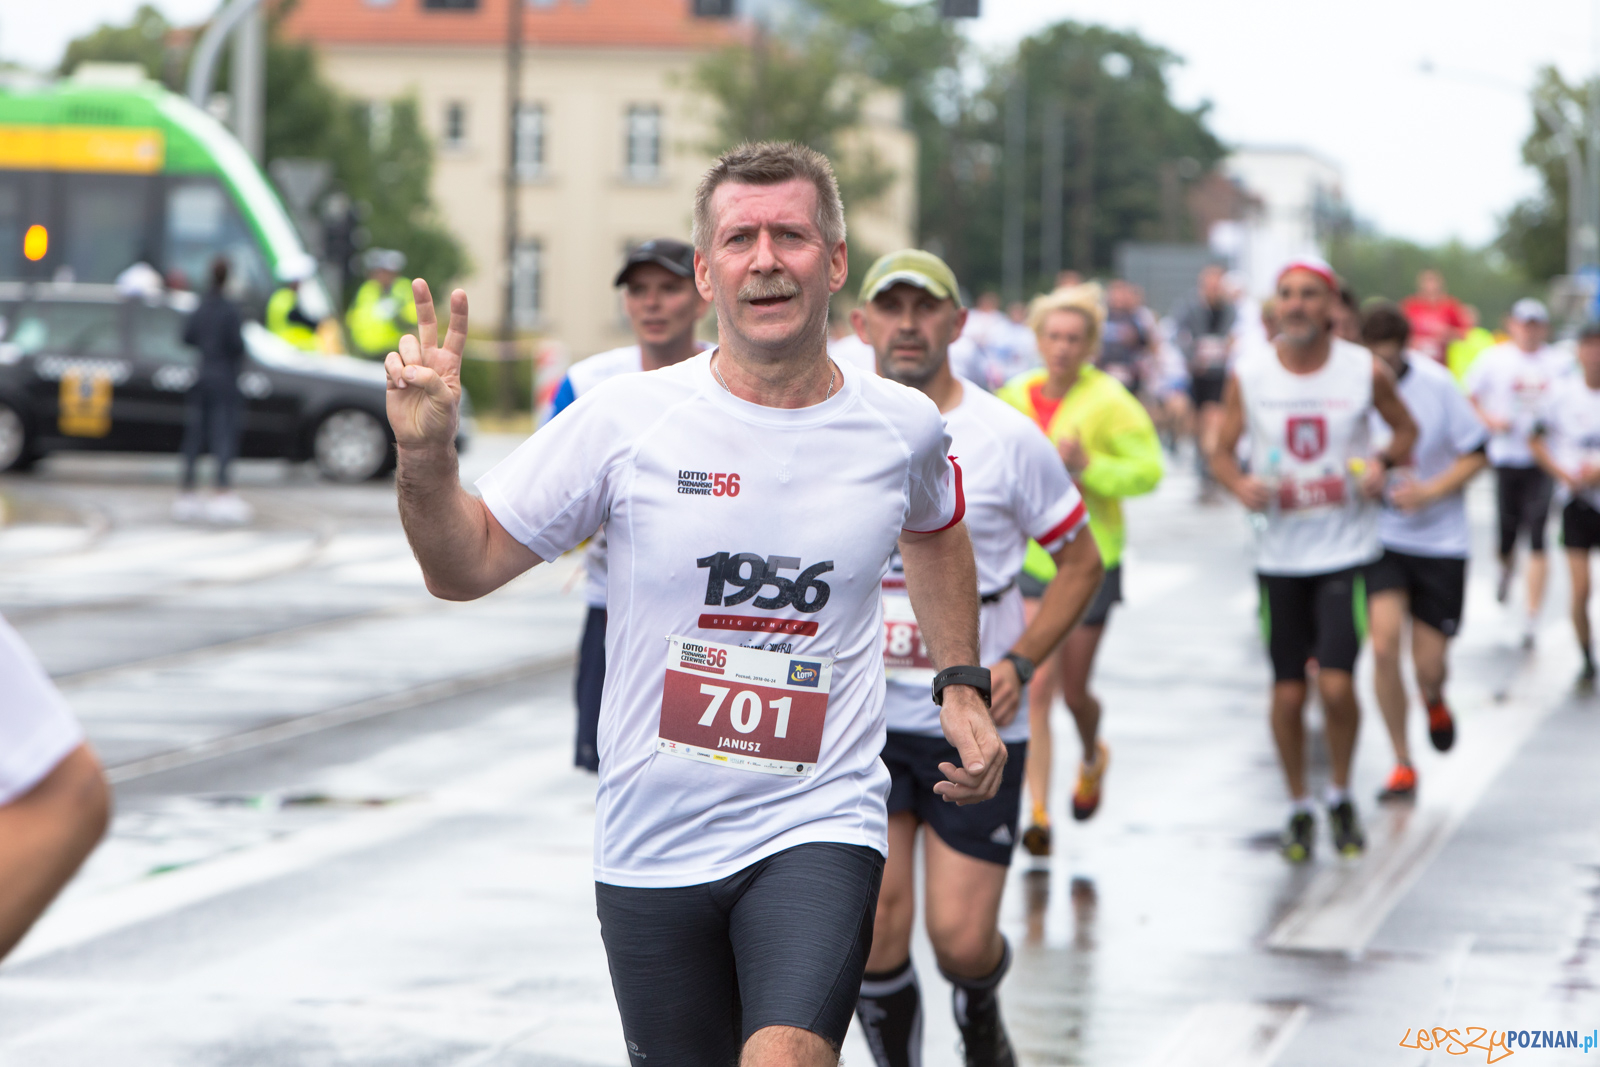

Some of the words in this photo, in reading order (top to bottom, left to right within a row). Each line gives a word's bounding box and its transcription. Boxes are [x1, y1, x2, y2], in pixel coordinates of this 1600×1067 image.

[678, 470, 708, 481] LOTTO
[677, 486, 712, 496] CZERWIEC
[697, 551, 835, 613] 1956
[713, 618, 742, 626] BIEG
[682, 642, 704, 653] LOTTO
[796, 671, 813, 680] LOTTO
[697, 683, 793, 739] 701
[717, 736, 762, 753] JANUSZ
